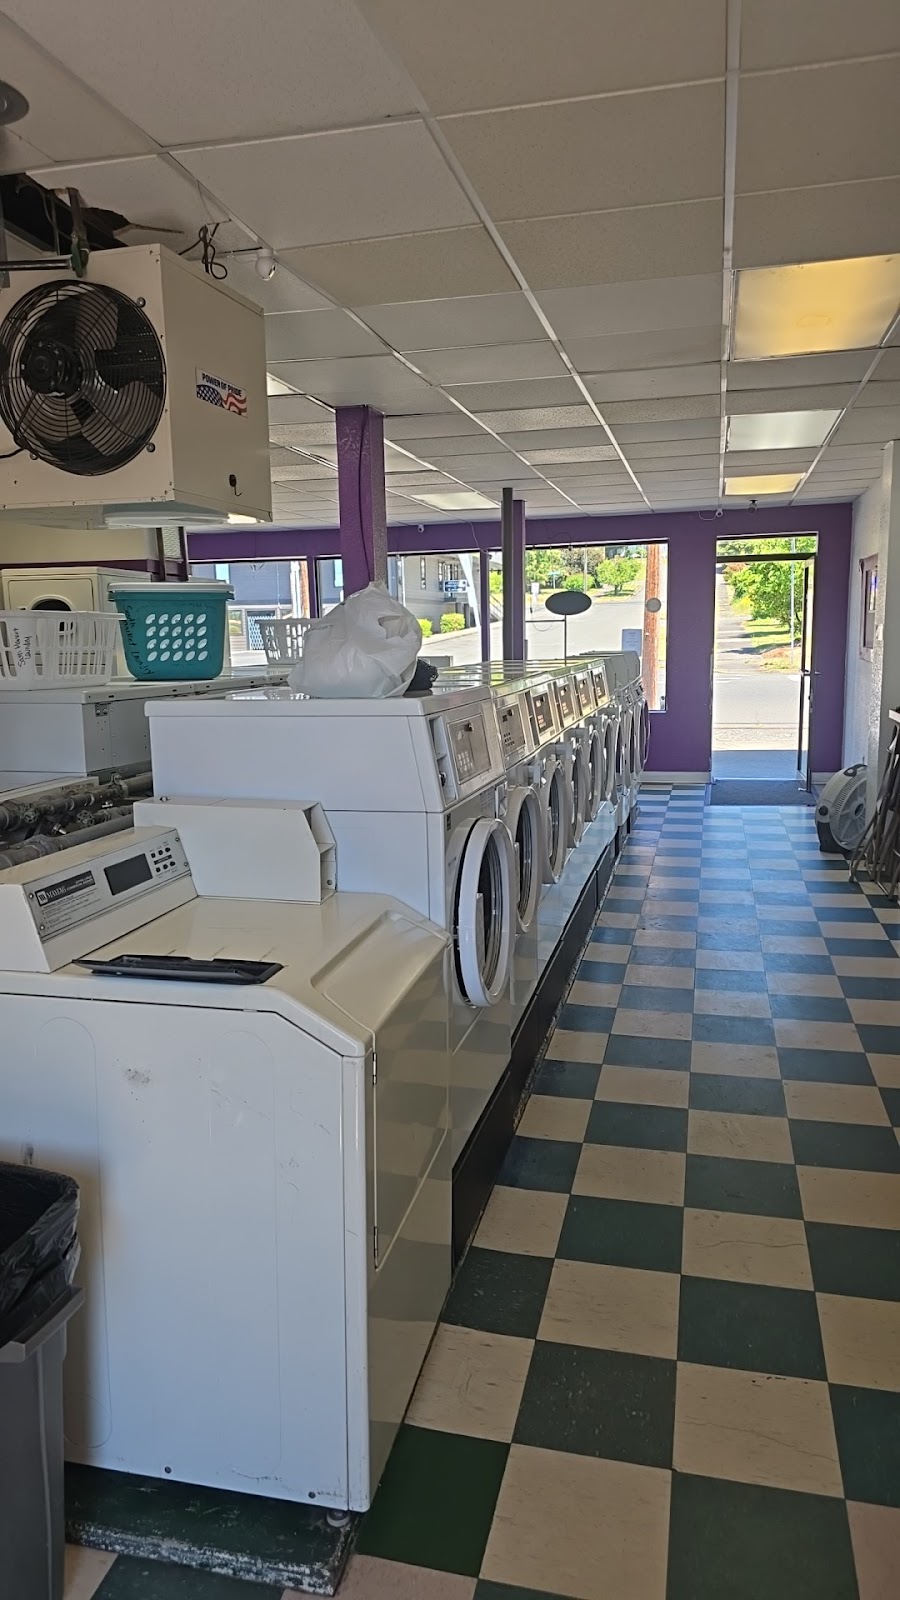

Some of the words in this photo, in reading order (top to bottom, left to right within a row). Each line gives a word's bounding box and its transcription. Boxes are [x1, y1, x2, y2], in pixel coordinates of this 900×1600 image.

[202, 373, 221, 388] POWER
[221, 381, 227, 390] OF
[228, 385, 242, 397] PRIDE
